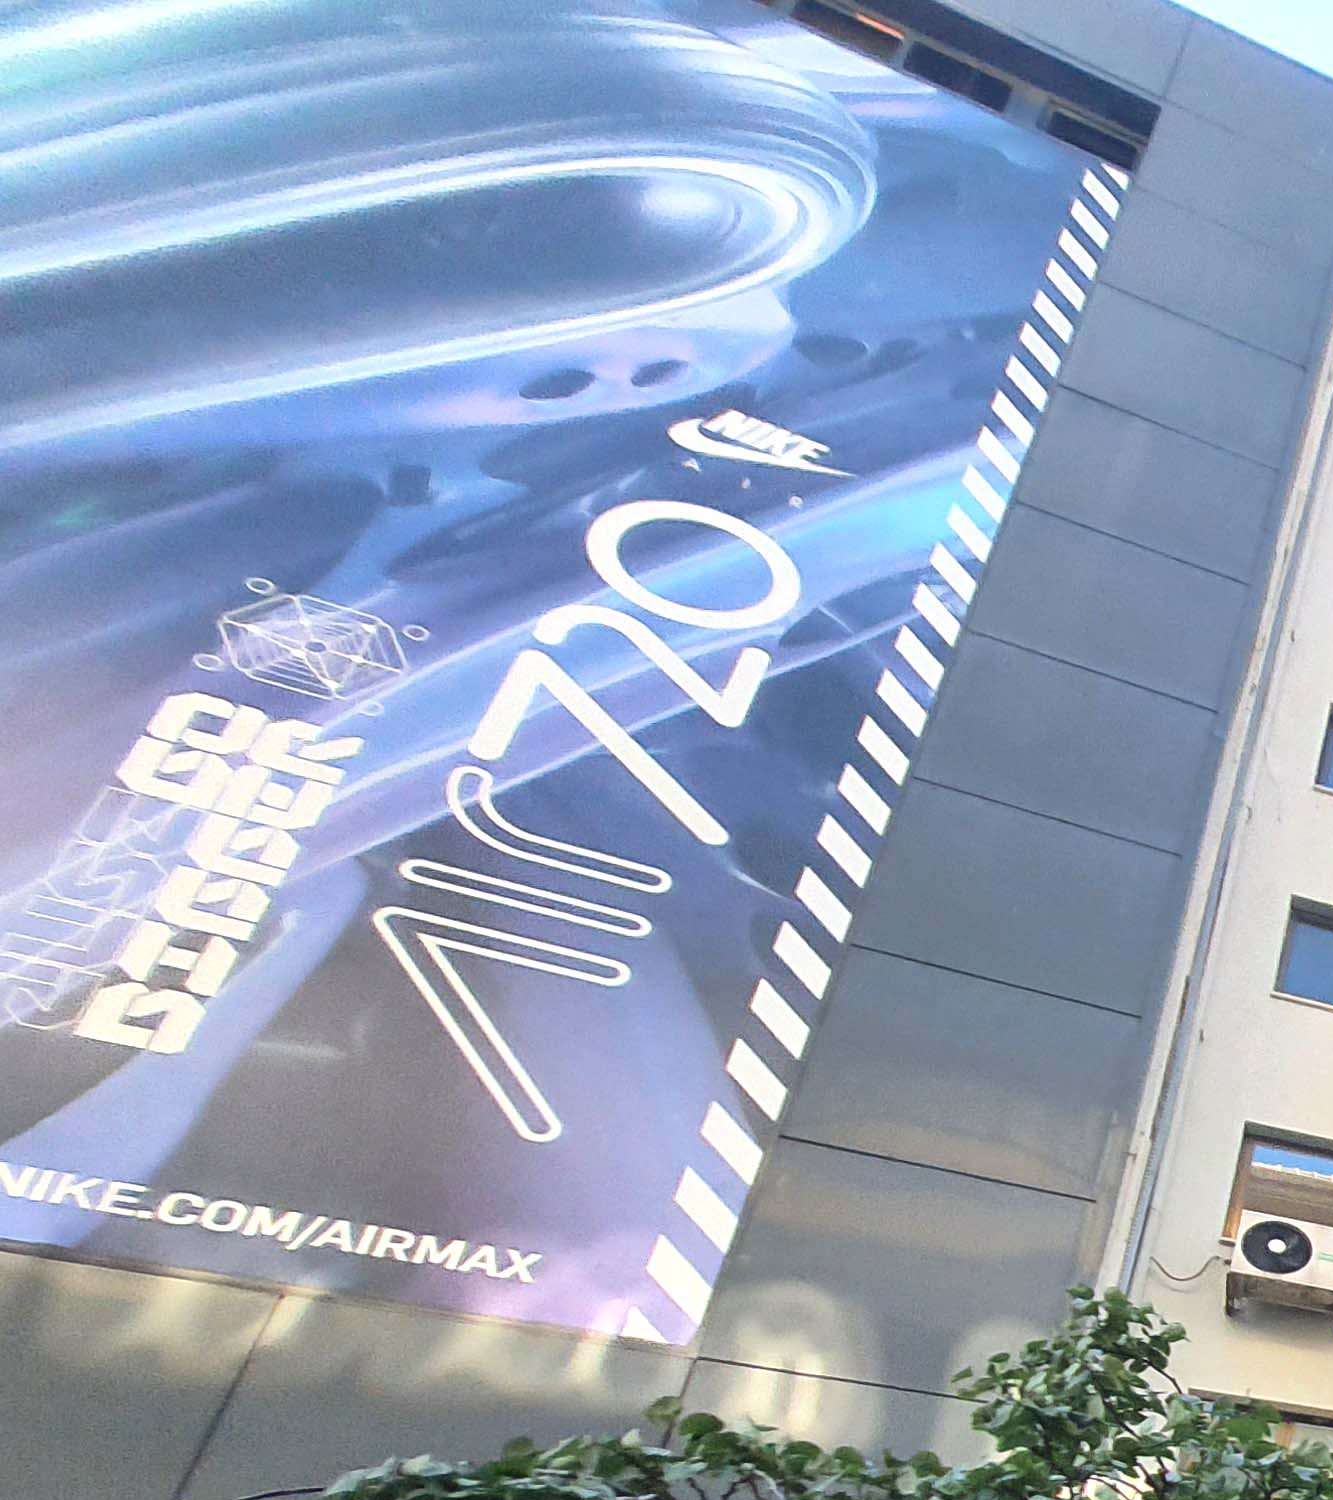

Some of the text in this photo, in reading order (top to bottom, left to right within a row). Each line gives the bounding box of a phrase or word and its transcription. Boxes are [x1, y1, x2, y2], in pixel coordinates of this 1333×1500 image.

[701, 407, 833, 459] NIKE
[73, 719, 365, 1055] BIGGER
[0, 1161, 543, 1283] NIKE.COM/AIRMAX
